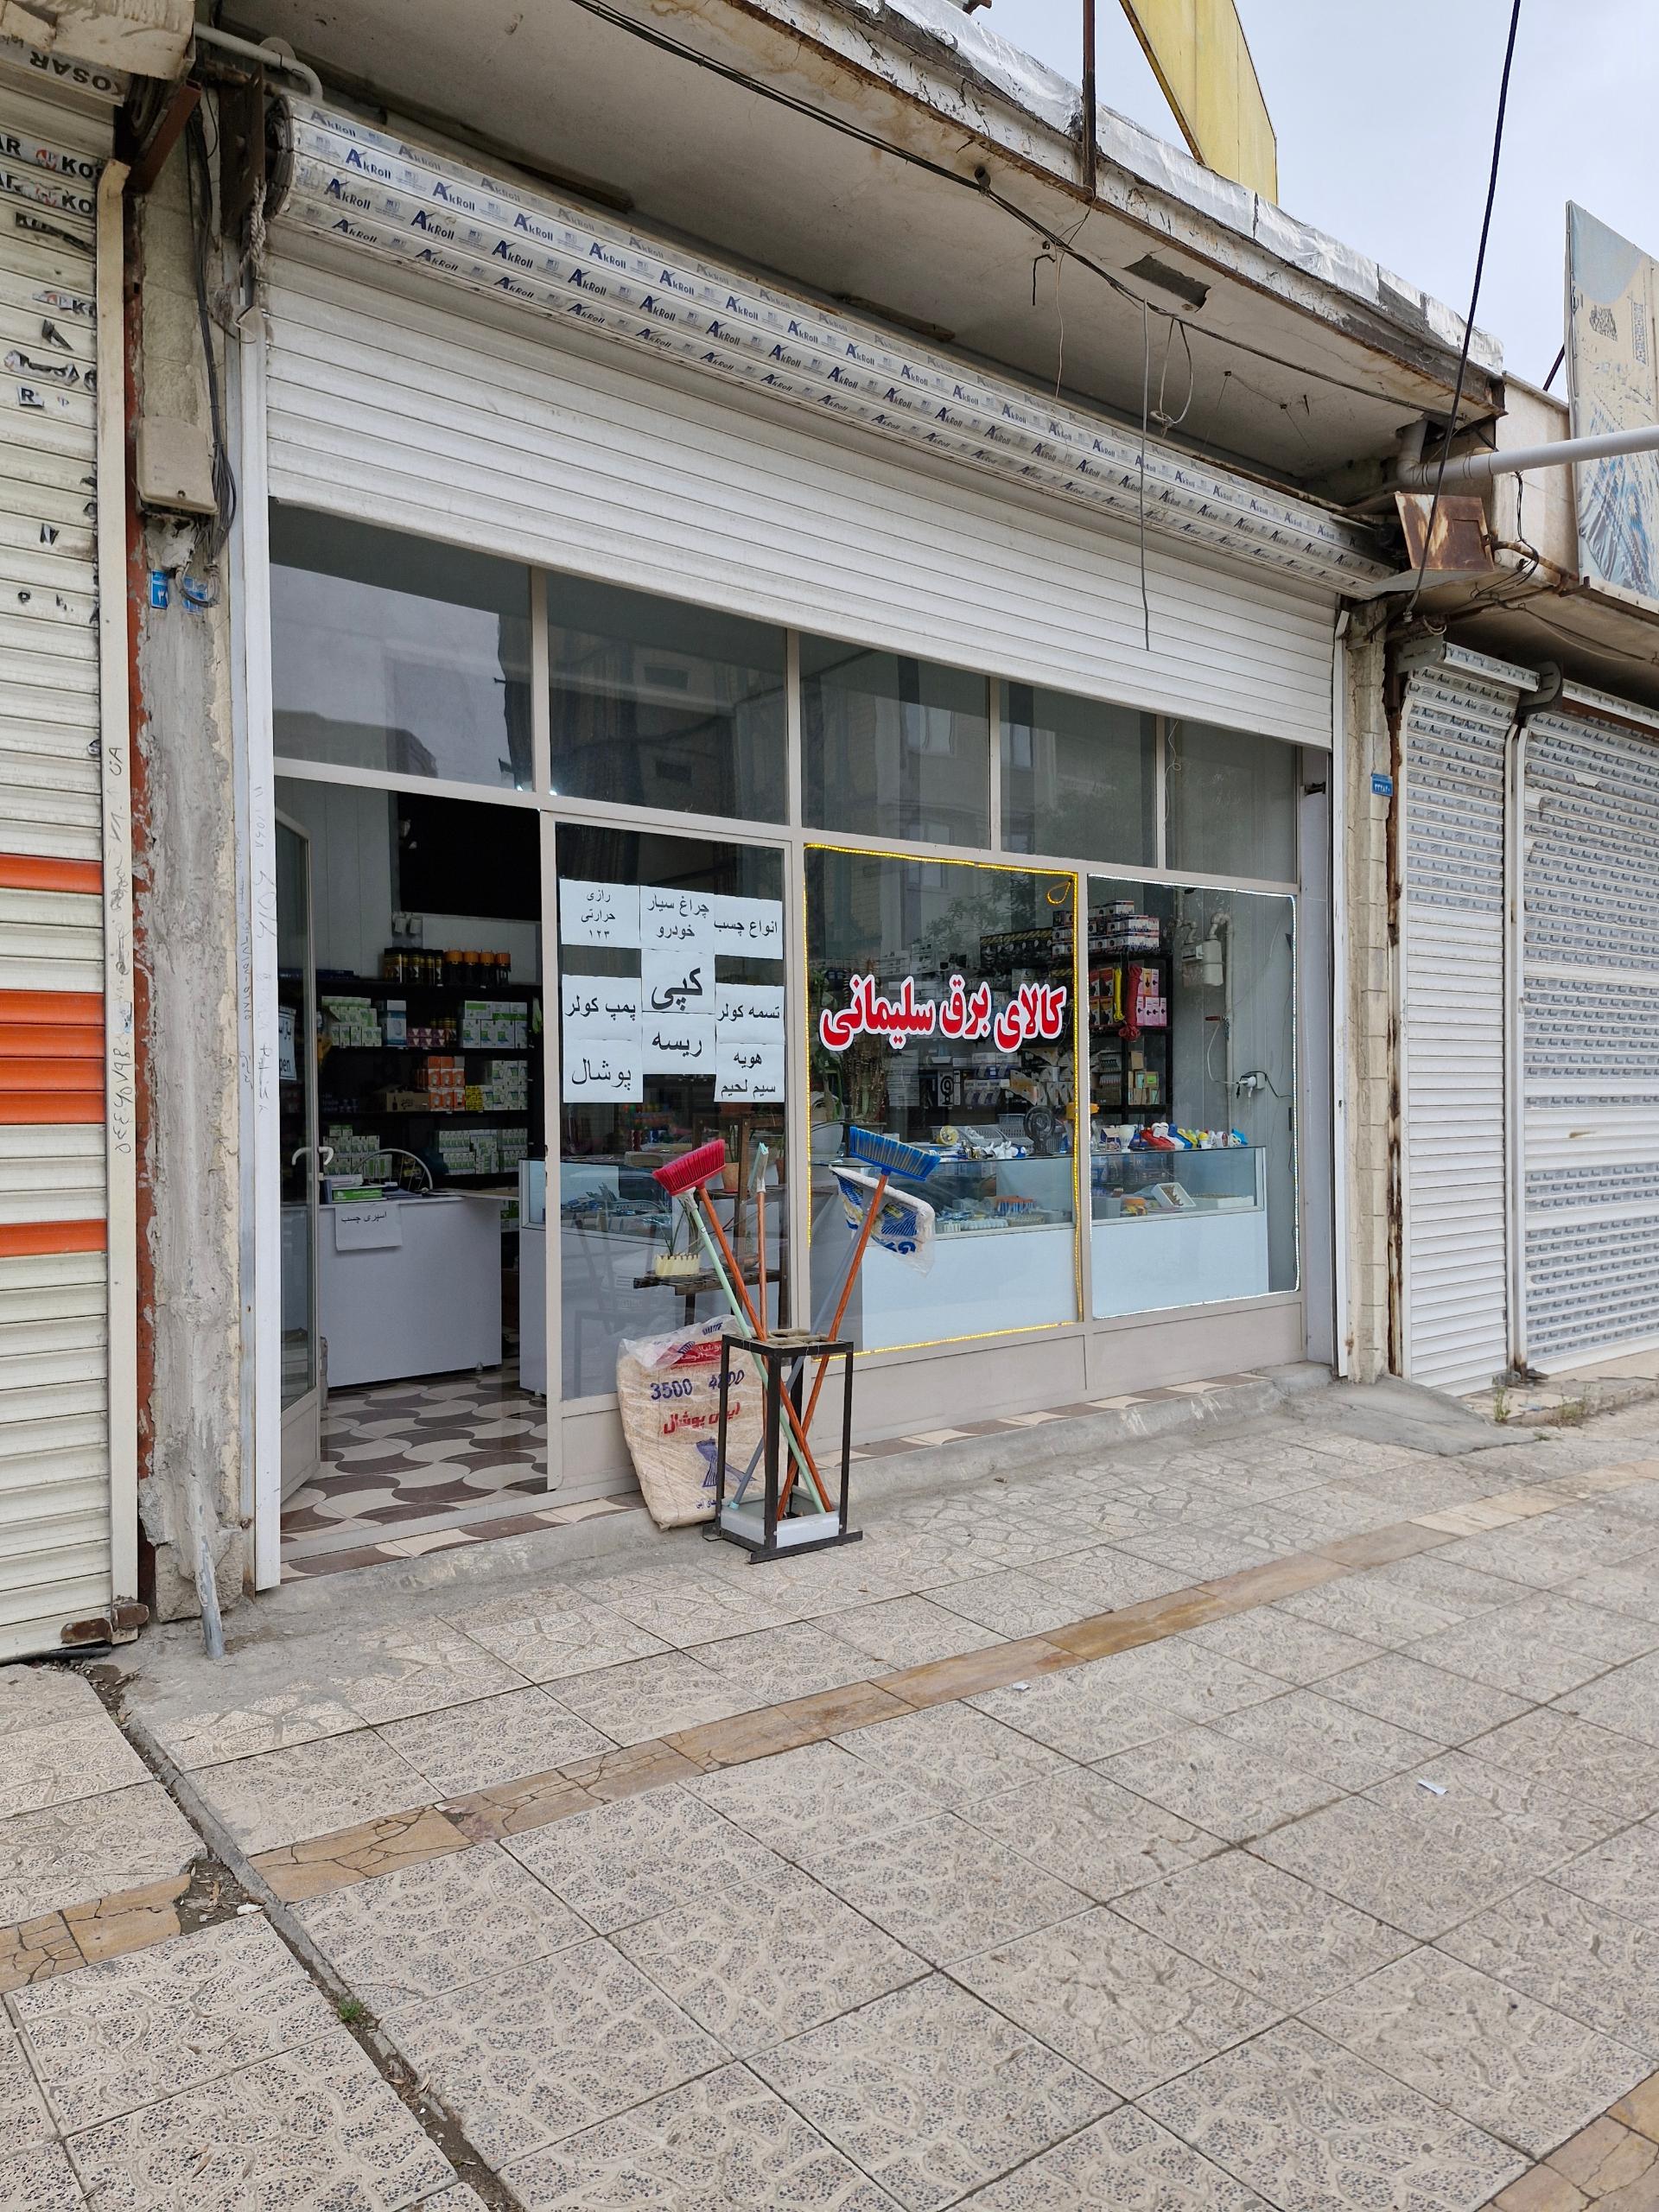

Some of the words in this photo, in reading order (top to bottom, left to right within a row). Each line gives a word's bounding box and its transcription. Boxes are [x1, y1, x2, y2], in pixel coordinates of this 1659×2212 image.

[310, 110, 355, 137] AkRoll
[346, 148, 391, 180] AkRoll
[432, 181, 474, 211] AkRoll
[513, 213, 553, 241] AkRoll
[588, 242, 626, 270] AkRoll
[659, 270, 694, 296] AkRoll
[725, 296, 759, 321] AkRoll
[787, 320, 818, 344] AkRoll
[845, 343, 874, 365] AkRoll
[900, 365, 928, 386] AkRoll
[952, 385, 978, 406] AkRoll
[1001, 404, 1027, 424] AkRoll
[1048, 421, 1071, 441] AkRoll
[1092, 439, 1116, 457] AkRoll
[1135, 455, 1156, 474] AkRoll
[323, 178, 371, 210] AkRoll
[410, 210, 454, 240] AkRoll
[492, 239, 533, 269] AkRoll
[568, 269, 607, 296] AkRoll
[639, 296, 676, 321] AkRoll
[705, 321, 741, 346] AkRoll
[768, 344, 801, 368] AkRoll
[827, 366, 858, 390] AkRoll
[882, 387, 912, 409] AkRoll
[935, 406, 963, 429] AkRoll
[984, 425, 1010, 445] AkRoll
[1031, 442, 1056, 462] AkRoll
[1076, 459, 1099, 478] AkRoll
[1118, 475, 1141, 493] AkRoll
[332, 219, 378, 244] AkRoll
[415, 248, 458, 272] AkRoll
[493, 276, 534, 299] AkRoll
[567, 303, 605, 325] AkRoll
[635, 327, 671, 348] AkRoll
[700, 352, 734, 372] AkRoll
[760, 373, 792, 392] AkRoll
[871, 414, 900, 431] AkRoll
[586, 892, 612, 904] رازی
[646, 893, 675, 912] سیار
[679, 894, 710, 918] چراغ
[581, 907, 616, 923] حرارتی
[588, 930, 610, 940] ۱۲۳
[656, 923, 696, 940] خودرو
[713, 918, 745, 936] چسب
[748, 921, 779, 939] انواع
[651, 967, 703, 1012] کپی
[564, 997, 600, 1018] کولر
[605, 1001, 637, 1022] پمپ
[715, 1004, 745, 1022] کولر
[747, 1005, 781, 1020] تسمه
[819, 973, 937, 1052] سلیمانی
[939, 974, 992, 1040] برق
[993, 982, 1068, 1053] کالای
[651, 1030, 703, 1058] ریسه
[733, 1051, 763, 1068] هویه
[571, 1058, 632, 1091] پوشال
[720, 1077, 749, 1099] لحیم
[752, 1085, 777, 1099] سیم
[650, 1377, 694, 1401] 3500
[708, 1369, 746, 1390] 400
[663, 1411, 705, 1433] پوشال
